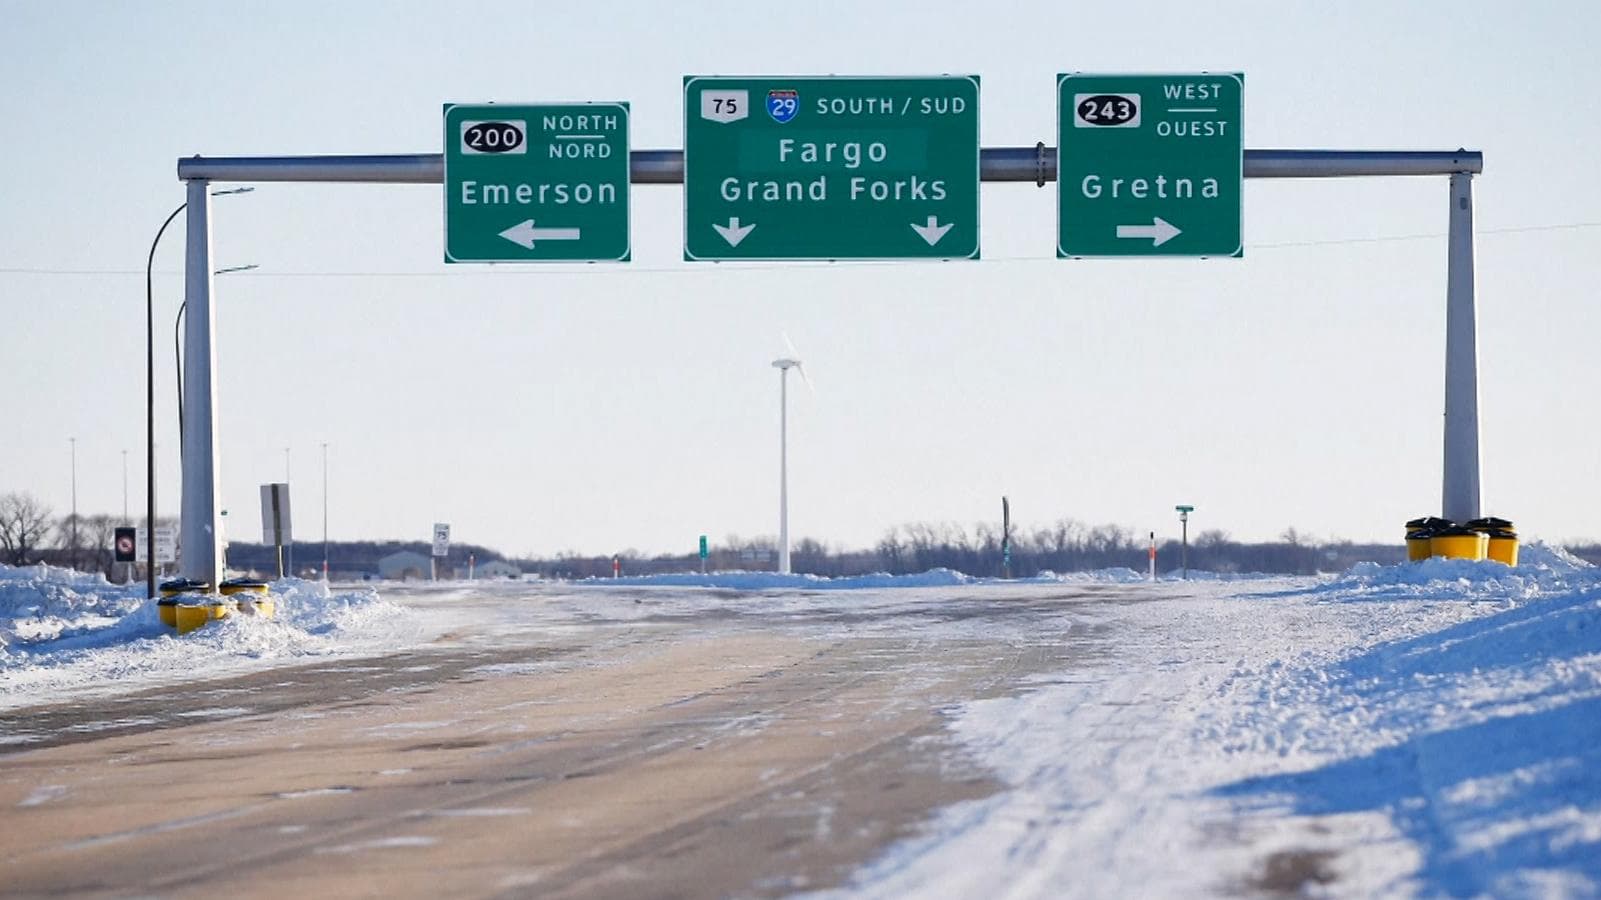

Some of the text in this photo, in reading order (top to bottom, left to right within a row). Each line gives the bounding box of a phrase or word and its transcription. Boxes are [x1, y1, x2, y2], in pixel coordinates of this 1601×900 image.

[1163, 84, 1221, 99] WEST
[711, 98, 738, 115] 75
[772, 99, 796, 116] 29
[817, 97, 966, 116] SOUTH / SUD
[1083, 100, 1131, 122] 243
[543, 115, 618, 131] NORTH
[1156, 121, 1228, 136] OUEST
[470, 128, 518, 148] 200
[549, 143, 612, 159] NORD
[779, 139, 887, 169] Fargo
[461, 181, 616, 205] Emerson
[720, 176, 947, 202] Grand Forks
[1081, 175, 1218, 199] Gretna
